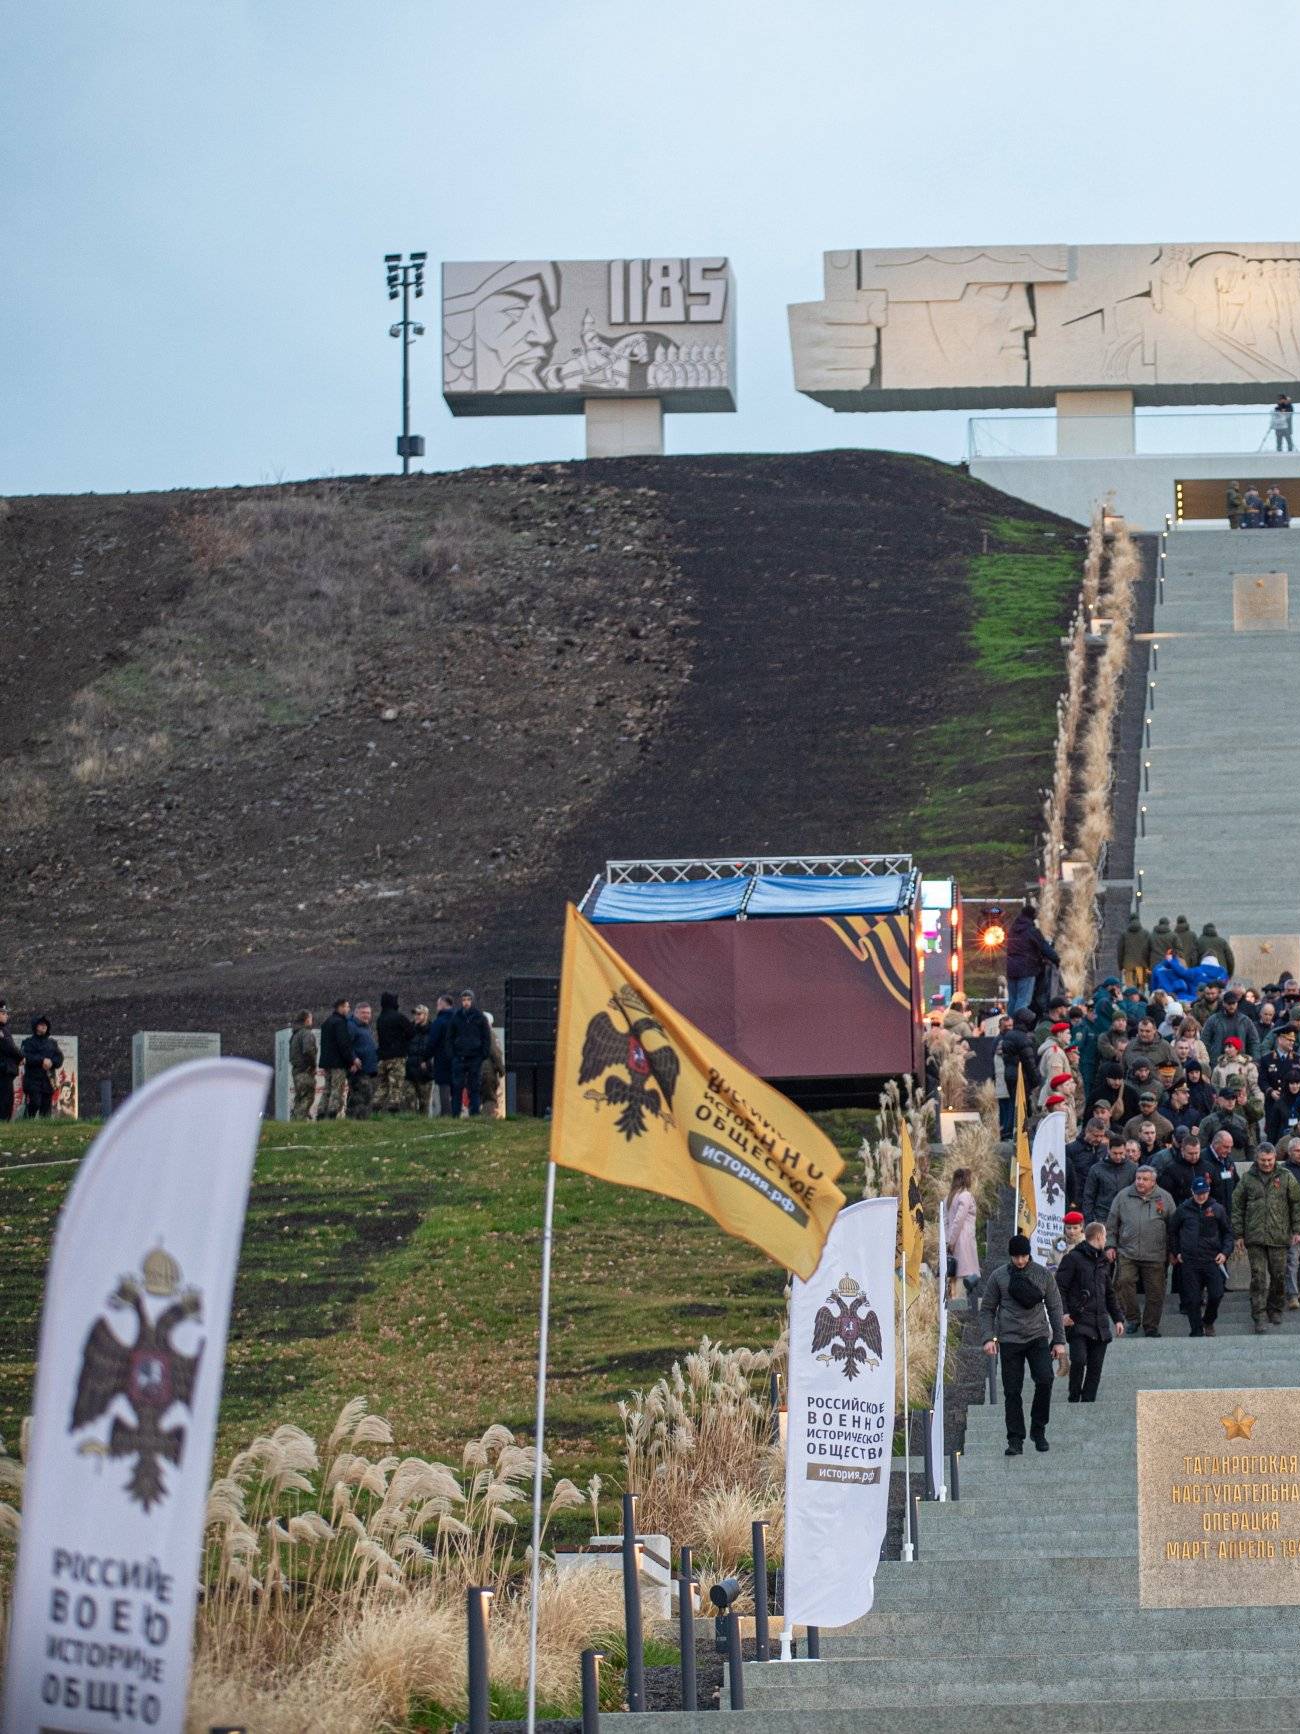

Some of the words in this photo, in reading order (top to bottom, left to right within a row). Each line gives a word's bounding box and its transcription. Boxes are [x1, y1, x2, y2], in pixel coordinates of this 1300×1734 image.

[608, 257, 727, 324] 1185
[701, 1145, 796, 1213] история.рф
[807, 1396, 885, 1415] РОССИЙСКОЕ
[807, 1411, 885, 1431] ВОЕННО
[806, 1428, 884, 1444] ИСТОРИЧЕСКОЕ
[806, 1442, 883, 1460] ОБЩЕСТВО
[1183, 1455, 1299, 1475] ТАГАНРОГСКАЯ
[819, 1468, 875, 1483] история.рф
[1202, 1511, 1281, 1532] ОПЕРАЦИЯ
